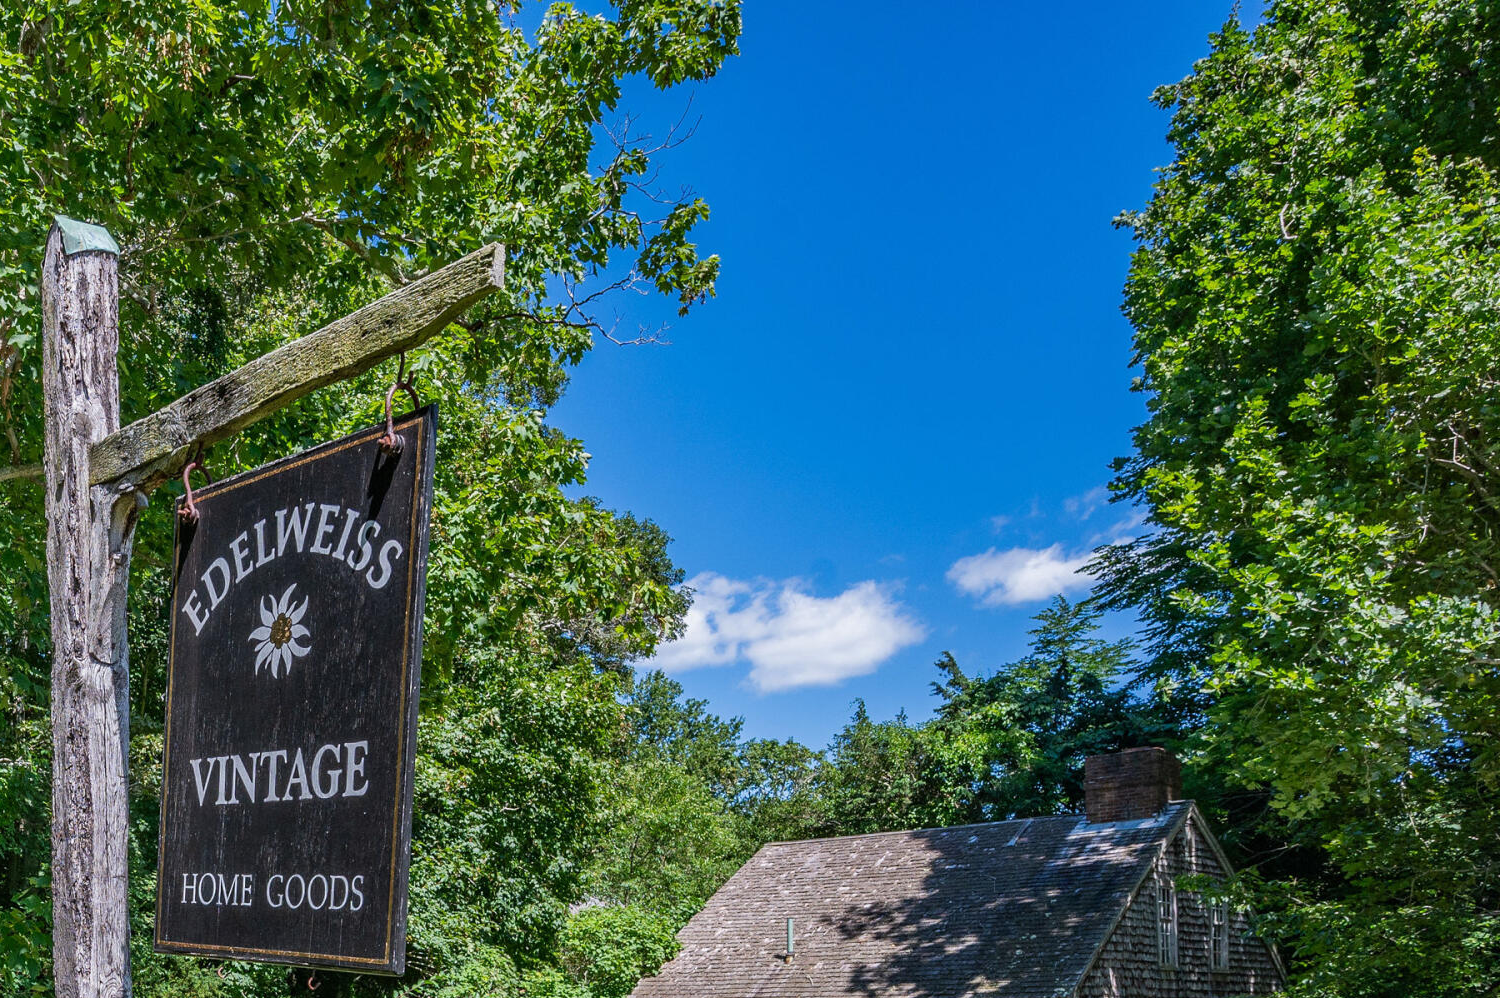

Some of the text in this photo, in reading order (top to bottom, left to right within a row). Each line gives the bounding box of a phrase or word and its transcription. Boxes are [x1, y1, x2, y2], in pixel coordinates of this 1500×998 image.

[181, 502, 403, 637] EDELWEISS
[189, 740, 370, 807] VINTAGE
[180, 872, 365, 912] HOME GOODS
